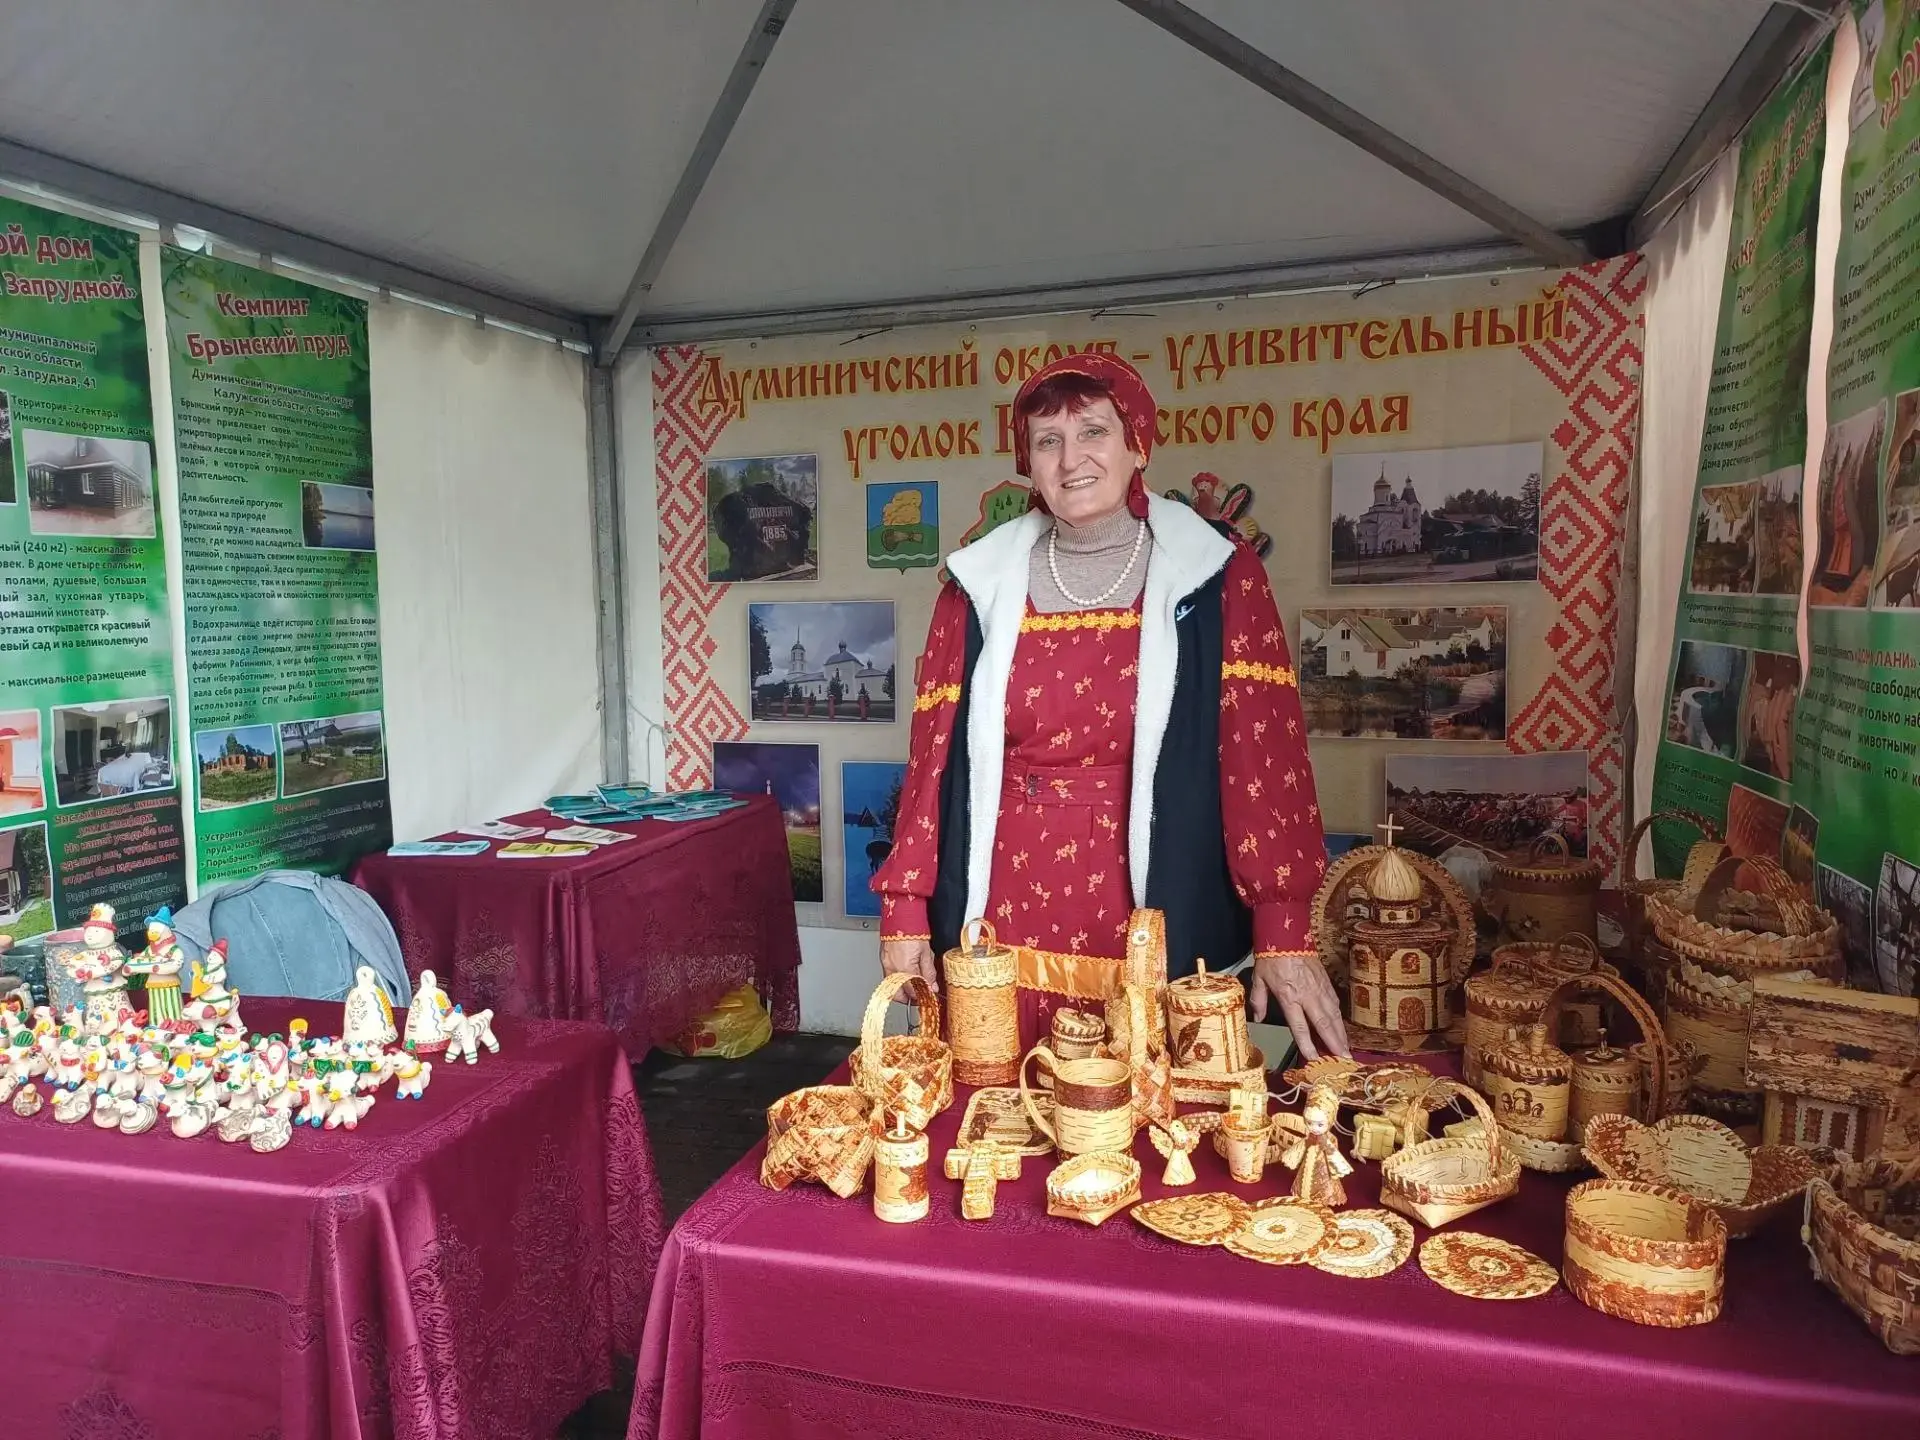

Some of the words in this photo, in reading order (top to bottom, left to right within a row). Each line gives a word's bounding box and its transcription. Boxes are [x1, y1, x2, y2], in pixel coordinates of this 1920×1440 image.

[37, 235, 94, 265] дом
[3, 271, 137, 304] Запрудной»
[216, 291, 310, 317] Кемпинг
[186, 327, 300, 365] Брынский
[302, 333, 352, 361] пруд
[697, 336, 982, 421] Думиничский
[1165, 285, 1572, 390] удивительный
[13, 365, 81, 388] Запрудная,
[83, 376, 97, 390] 41
[191, 368, 262, 389] Думиничский
[11, 394, 68, 413] Территория
[75, 404, 80, 414] 2
[214, 387, 271, 406] Калужской
[181, 397, 221, 413] Брынский
[221, 405, 245, 417] пруд
[254, 410, 267, 418] это
[13, 411, 56, 426] Имеются
[58, 417, 65, 426] 2
[65, 419, 125, 434] комфортных
[127, 427, 151, 436] дома
[216, 417, 266, 431] привлекает
[178, 427, 252, 445] умиротворяющей
[842, 419, 983, 480] уголок
[1291, 394, 1411, 455] края
[213, 446, 238, 455] лесов
[246, 449, 273, 460] полей,
[180, 455, 209, 468] водой,
[223, 461, 261, 472] которой
[181, 470, 249, 483] растительность.
[182, 492, 198, 503] Для
[198, 494, 245, 506] любителей
[246, 500, 284, 509] прогулок
[188, 509, 218, 518] отдыха
[231, 511, 267, 522] природе
[183, 520, 222, 532] Брынский
[223, 525, 244, 535] пруд
[250, 527, 294, 535] идеальное
[23, 541, 48, 555] (240
[50, 541, 68, 556] м2)
[76, 545, 144, 554] максимальное
[183, 536, 209, 546] место,
[210, 538, 225, 546] где
[255, 540, 303, 549] насладиться
[185, 549, 223, 560] тишиной,
[224, 551, 266, 561] подышать
[267, 553, 295, 561] свежим
[28, 558, 35, 569] В
[36, 561, 64, 572] доме
[65, 562, 100, 572] четыре
[102, 562, 145, 571] спальни,
[185, 564, 224, 573] единение
[231, 563, 273, 574] природой.
[273, 566, 295, 575] Здесь
[5, 577, 49, 588] полами,
[52, 577, 100, 589] душевые,
[103, 575, 147, 585] большая
[207, 578, 261, 588] одиночестве,
[27, 593, 49, 604] зал,
[55, 592, 103, 604] кухонная
[108, 592, 148, 603] утварь,
[186, 591, 239, 601] наслаждаясь
[240, 590, 276, 600] красотой
[284, 590, 330, 600] спокойствием
[55, 608, 110, 619] кинотеатр.
[209, 605, 241, 614] уголка.
[0, 625, 34, 635] этажа
[36, 623, 100, 636] открывается
[101, 618, 151, 633] красивый
[192, 619, 261, 632] Водохранилище
[284, 620, 314, 629] историю
[349, 616, 361, 626] Его
[361, 617, 377, 626] воды
[31, 641, 52, 652] сад
[53, 641, 60, 649] и
[61, 640, 74, 649] на
[75, 636, 149, 648] великолепную
[191, 634, 233, 645] отдавали
[237, 633, 259, 641] свою
[263, 631, 293, 643] энергию
[335, 629, 377, 639] производство
[191, 648, 222, 657] железа
[222, 646, 251, 656] завода
[252, 645, 294, 656] Демидовых,
[320, 642, 359, 652] производство
[192, 660, 228, 673] фабрики
[283, 657, 302, 666] когда
[303, 655, 329, 667] фабрика
[8, 674, 86, 688] максимальное
[86, 669, 147, 684] размещение
[192, 676, 212, 684] стал
[213, 671, 277, 684] «безработным»,
[286, 670, 298, 678] его
[298, 668, 317, 679] водах
[193, 689, 213, 698] вала
[214, 686, 233, 696] себя
[234, 686, 261, 697] разная
[262, 684, 287, 695] речная
[288, 681, 307, 693] рыба.
[314, 678, 345, 688] советский
[194, 699, 257, 712] использовался
[262, 696, 279, 706] СПК
[193, 712, 231, 725] товарной
[233, 712, 257, 723] рыбы.
[1864, 706, 1901, 726] только
[1858, 733, 1917, 758] животными
[1884, 766, 1898, 780] но
[205, 830, 243, 842] Устроить
[206, 865, 258, 881] возможность
